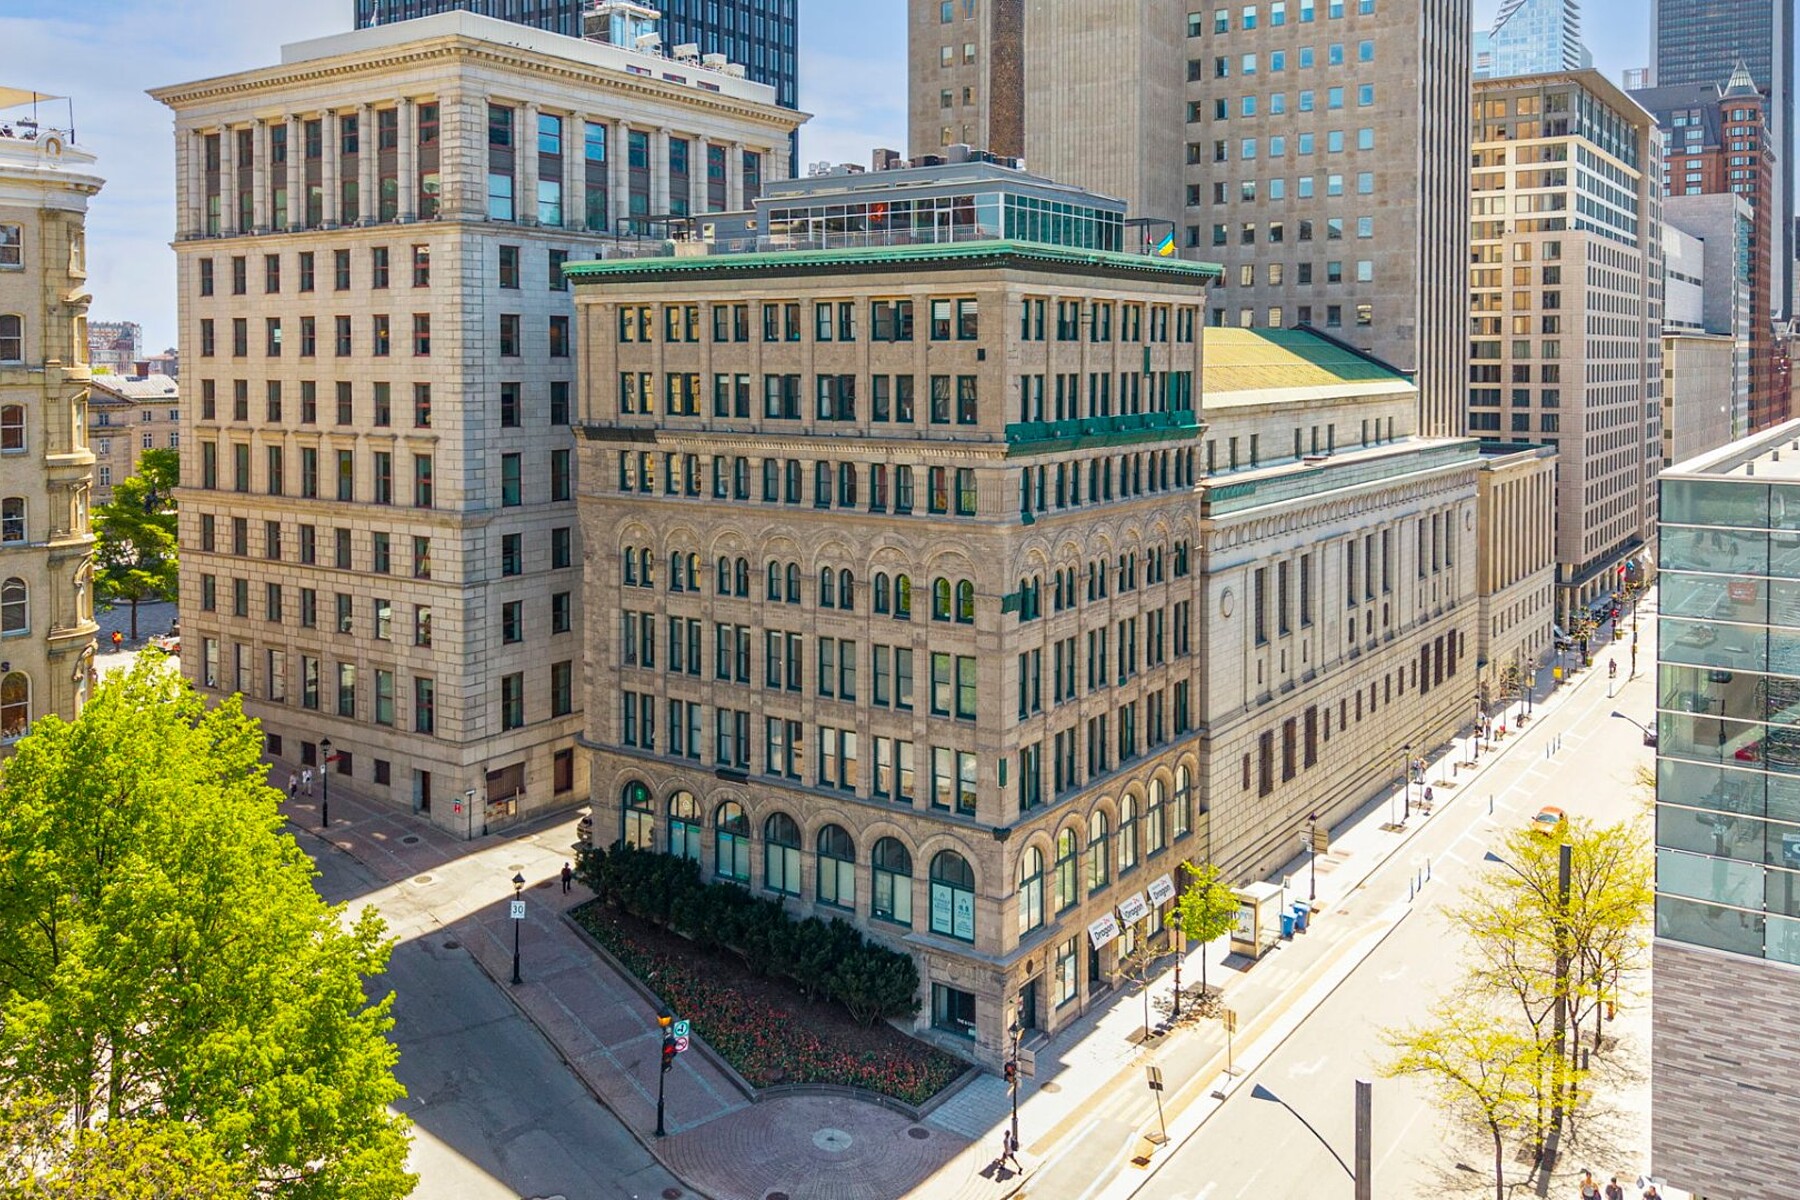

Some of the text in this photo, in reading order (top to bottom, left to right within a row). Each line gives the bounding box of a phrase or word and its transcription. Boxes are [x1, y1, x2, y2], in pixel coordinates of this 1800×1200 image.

[1153, 884, 1171, 900] Dragon
[512, 905, 524, 914] 30
[1125, 903, 1144, 919] Dragon
[1094, 923, 1115, 940] Dragon
